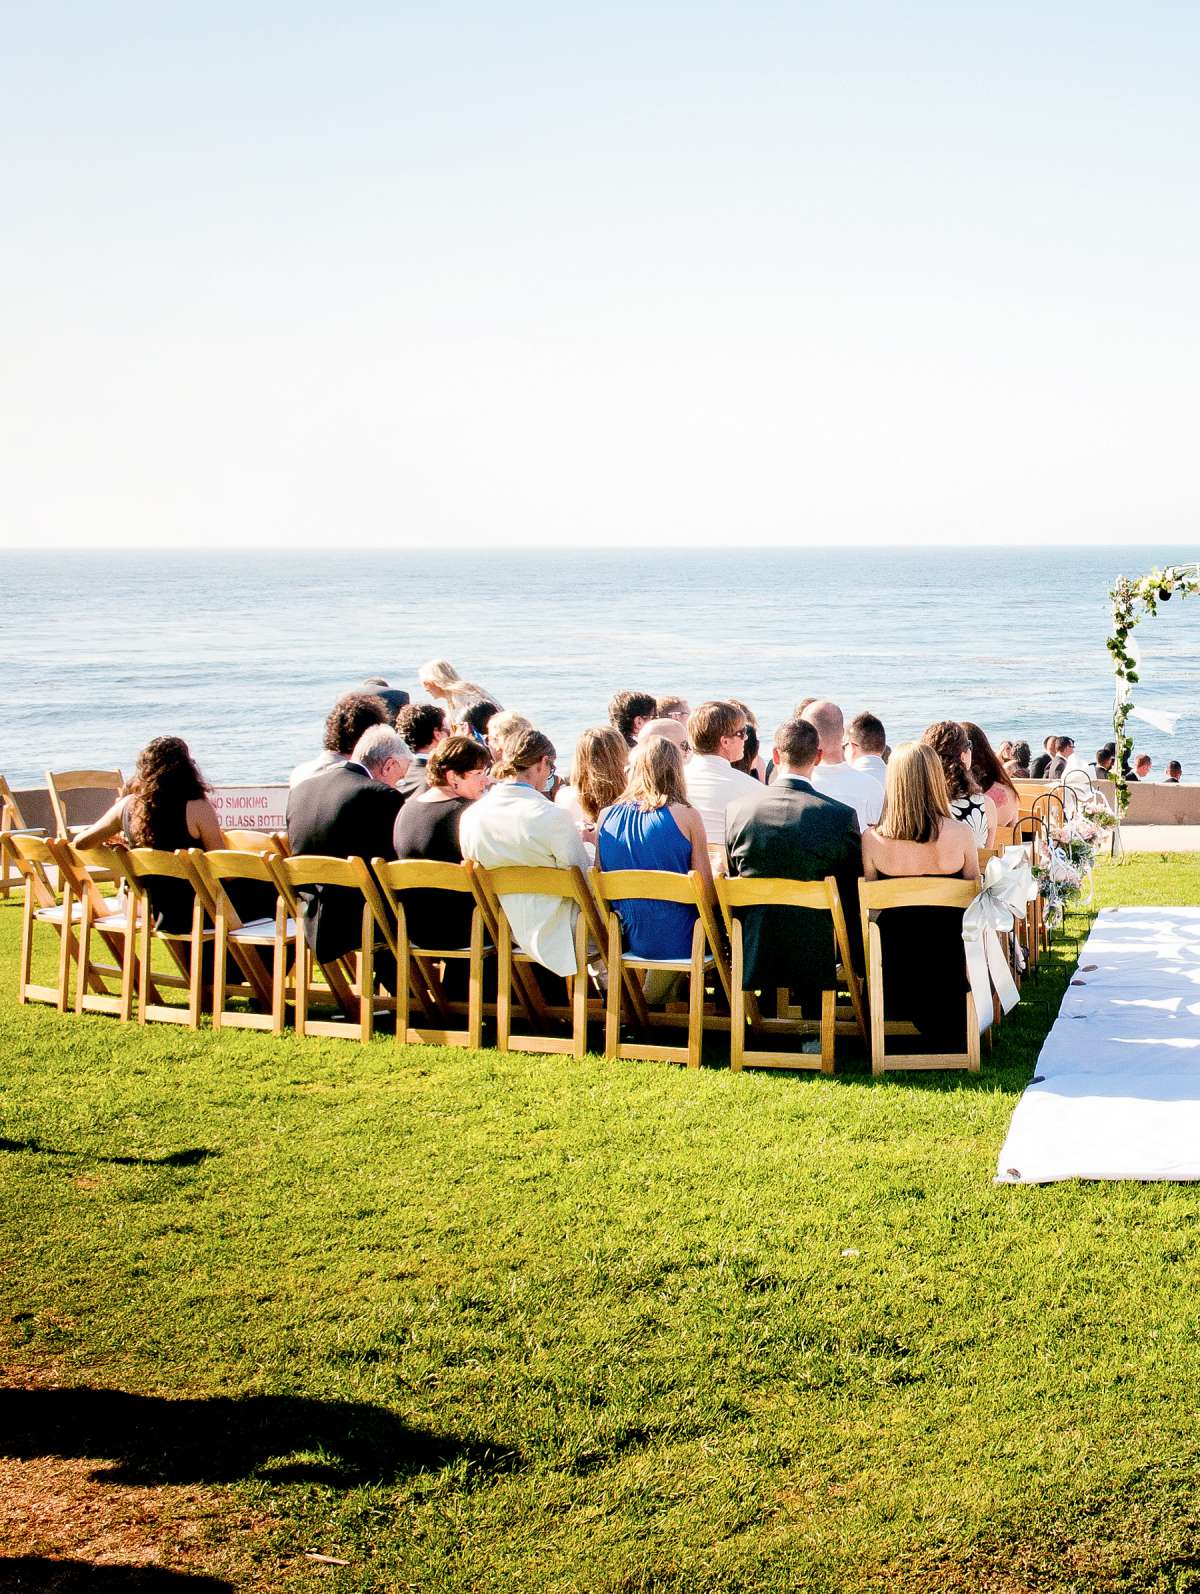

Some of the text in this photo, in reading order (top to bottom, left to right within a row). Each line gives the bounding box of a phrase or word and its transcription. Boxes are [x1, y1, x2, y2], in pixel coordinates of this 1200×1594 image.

[226, 796, 268, 809] SMOKING
[225, 815, 256, 827] GLASS
[257, 815, 287, 827] BOTTL
